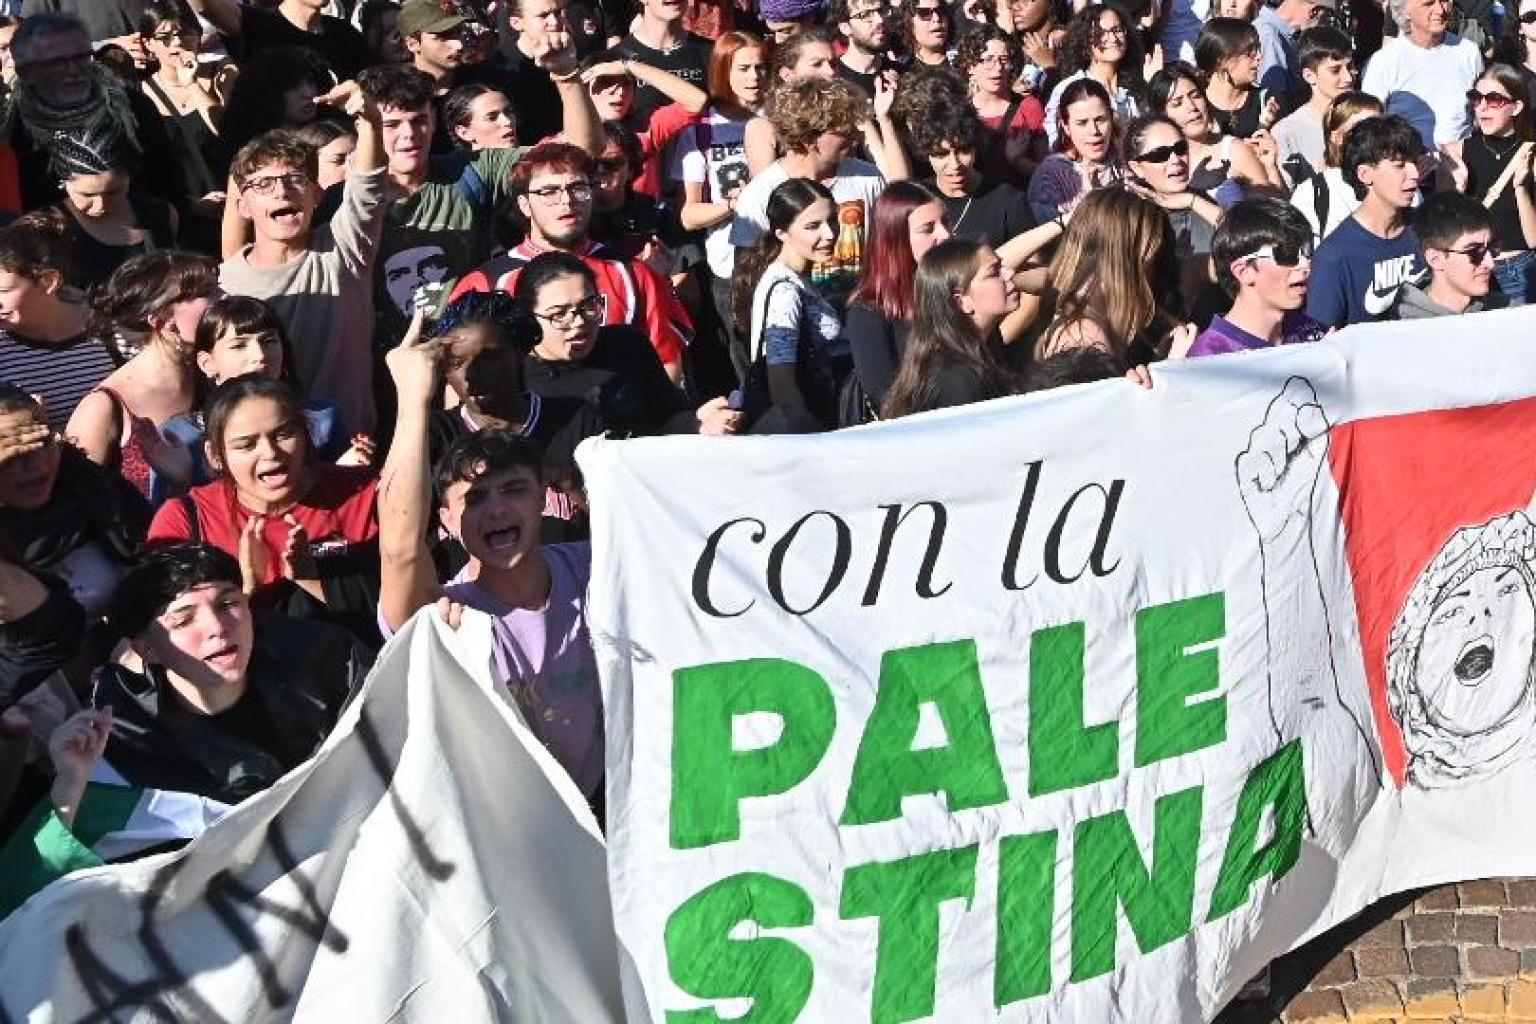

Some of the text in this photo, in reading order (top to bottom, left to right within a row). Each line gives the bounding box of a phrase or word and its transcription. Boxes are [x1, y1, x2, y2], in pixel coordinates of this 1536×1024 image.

[1374, 253, 1416, 291] NIKE
[691, 460, 1127, 619] con la
[668, 591, 1228, 850] PALE
[663, 737, 1312, 1024] STINA
